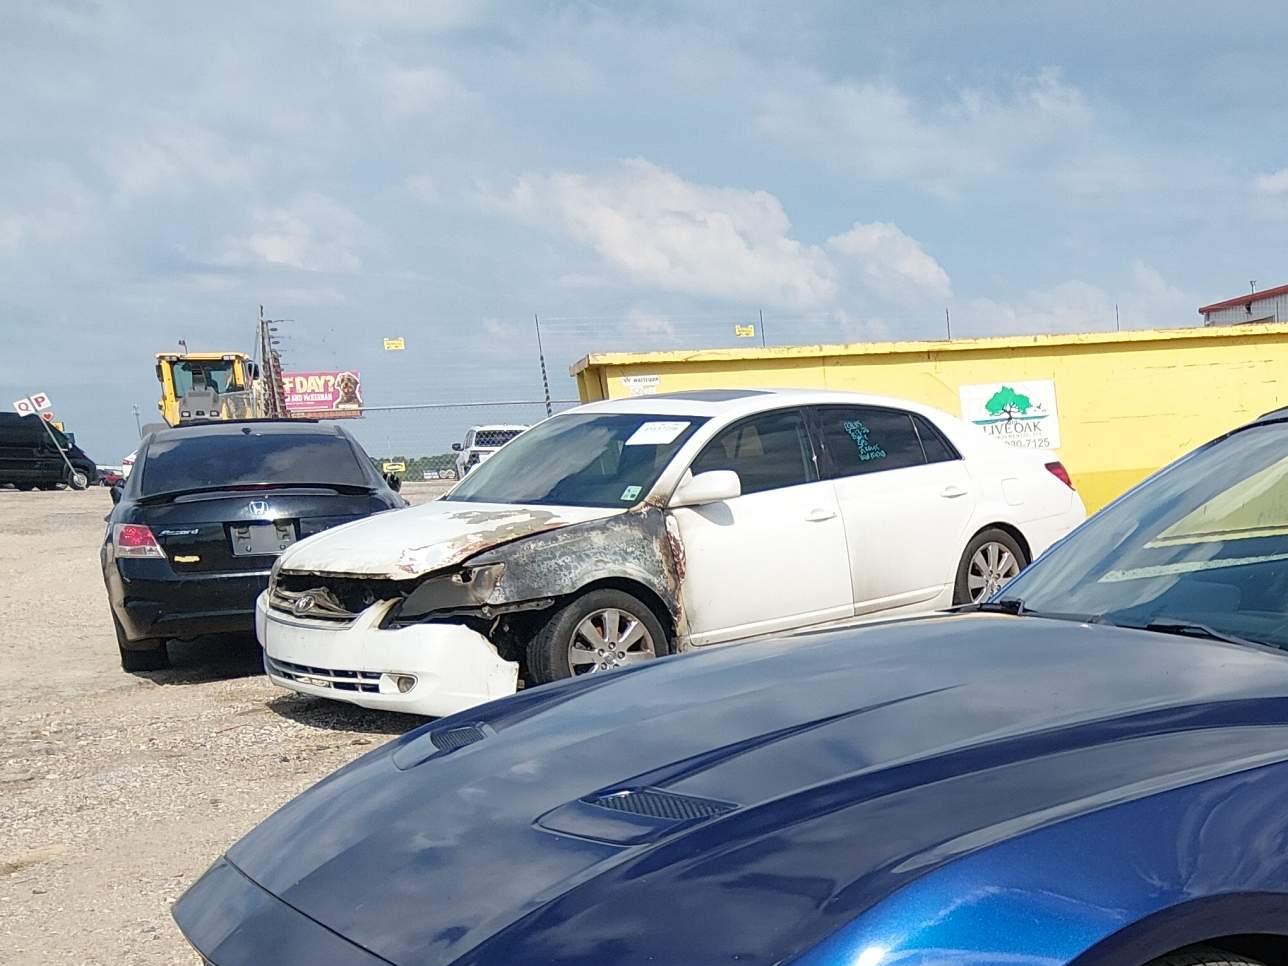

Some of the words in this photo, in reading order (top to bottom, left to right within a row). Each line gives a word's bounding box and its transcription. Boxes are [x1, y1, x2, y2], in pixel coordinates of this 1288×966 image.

[295, 375, 335, 393] DAY?
[18, 402, 32, 412] Q
[34, 395, 46, 408] P
[1014, 421, 1042, 433] OAK
[159, 528, 199, 537] Accord
